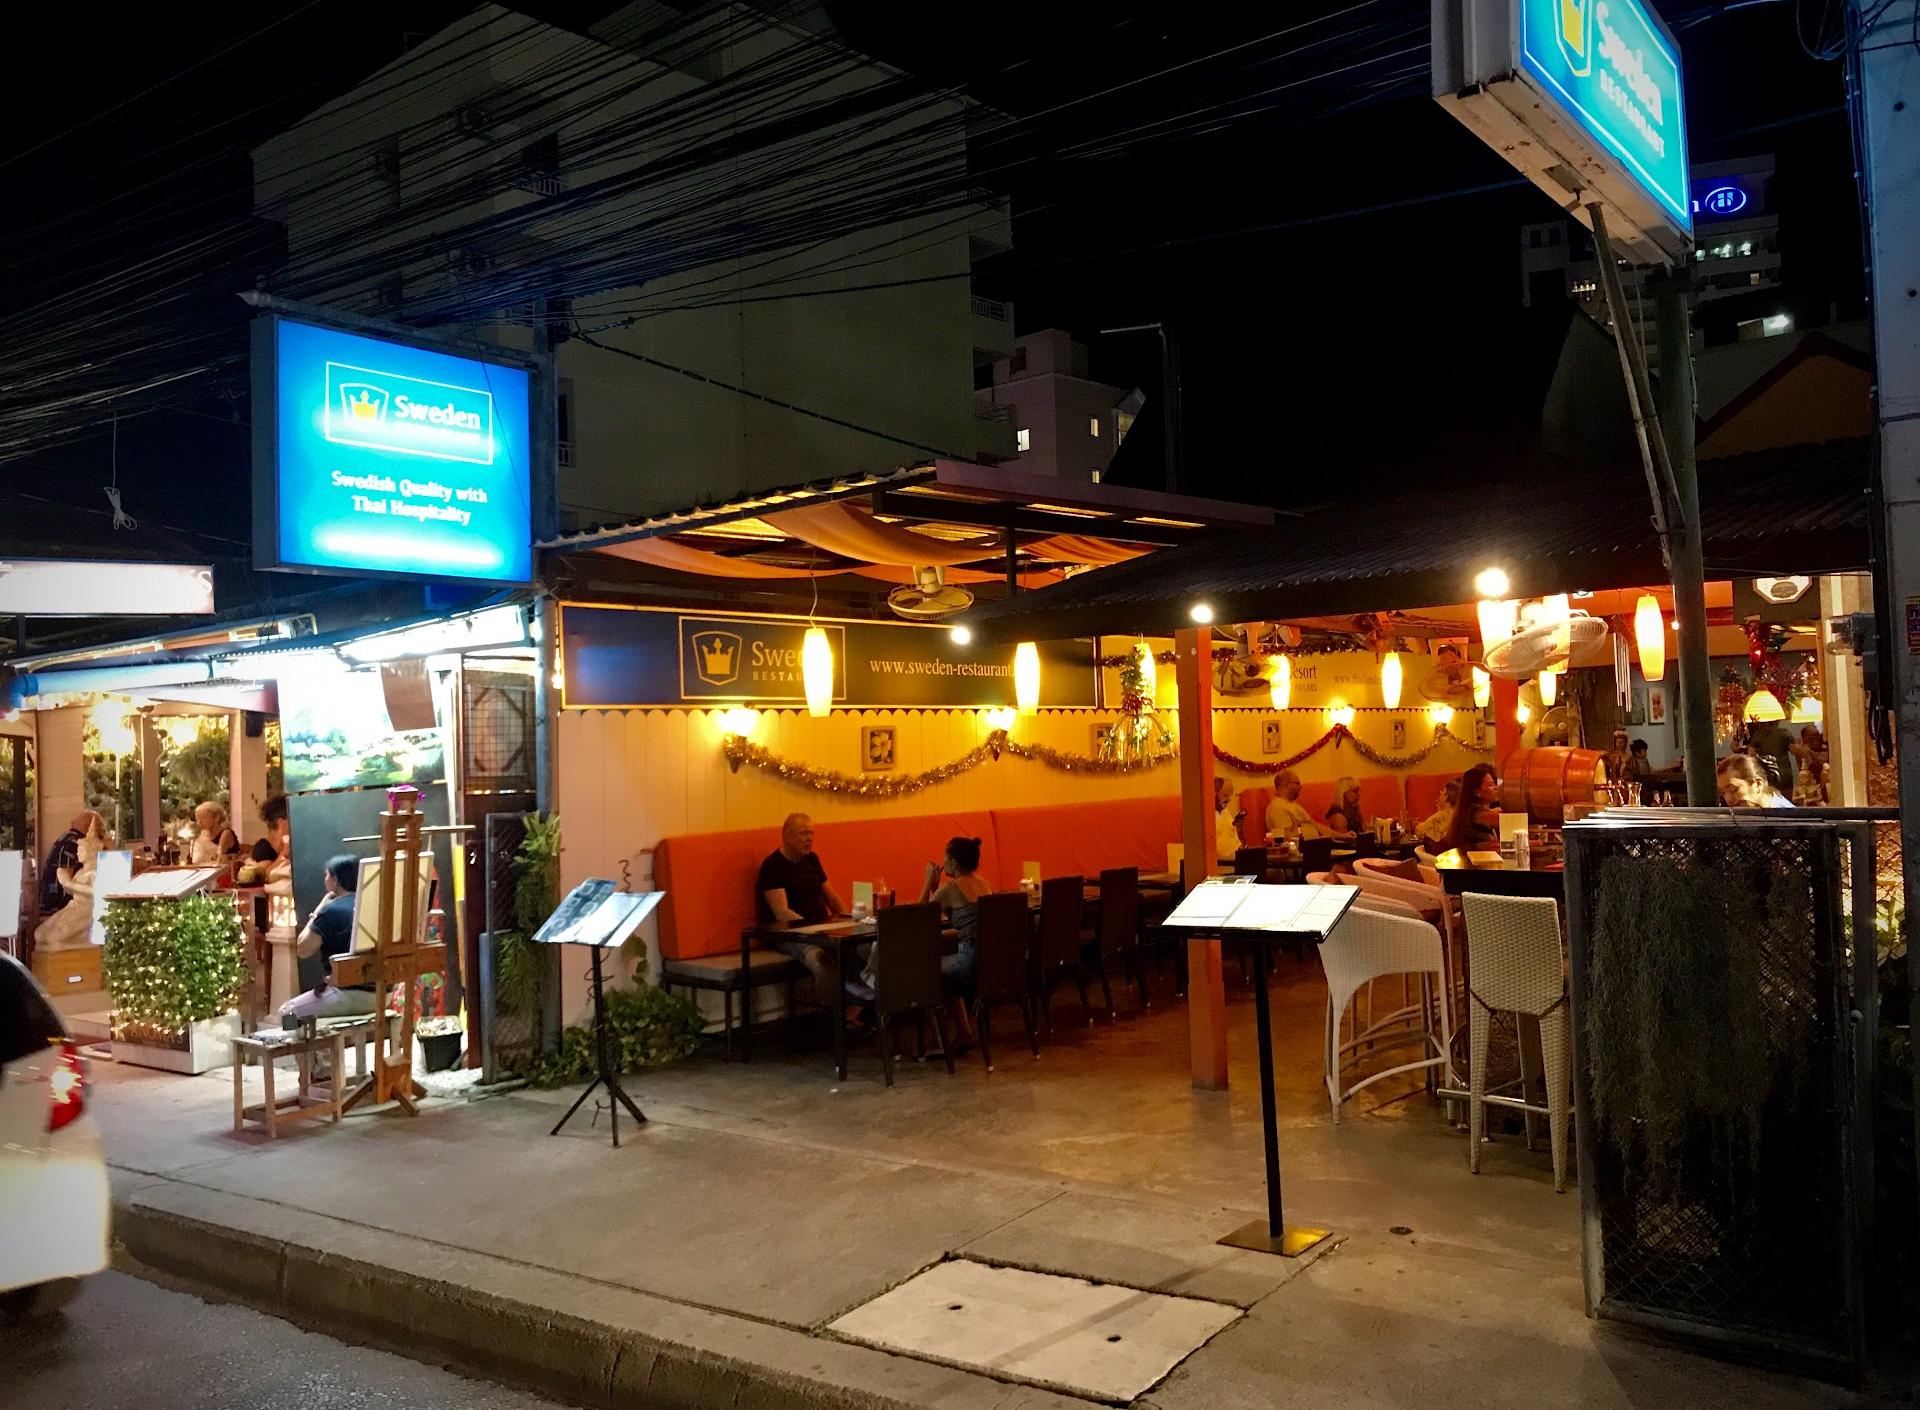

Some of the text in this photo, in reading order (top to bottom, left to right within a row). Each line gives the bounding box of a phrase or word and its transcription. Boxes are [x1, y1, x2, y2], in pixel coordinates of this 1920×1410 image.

[394, 394, 481, 430] Sweden
[331, 470, 489, 504] Swedish Quality with
[351, 495, 472, 527] Thai Hospitality
[869, 658, 1015, 678] www.sweden-restaurant.
